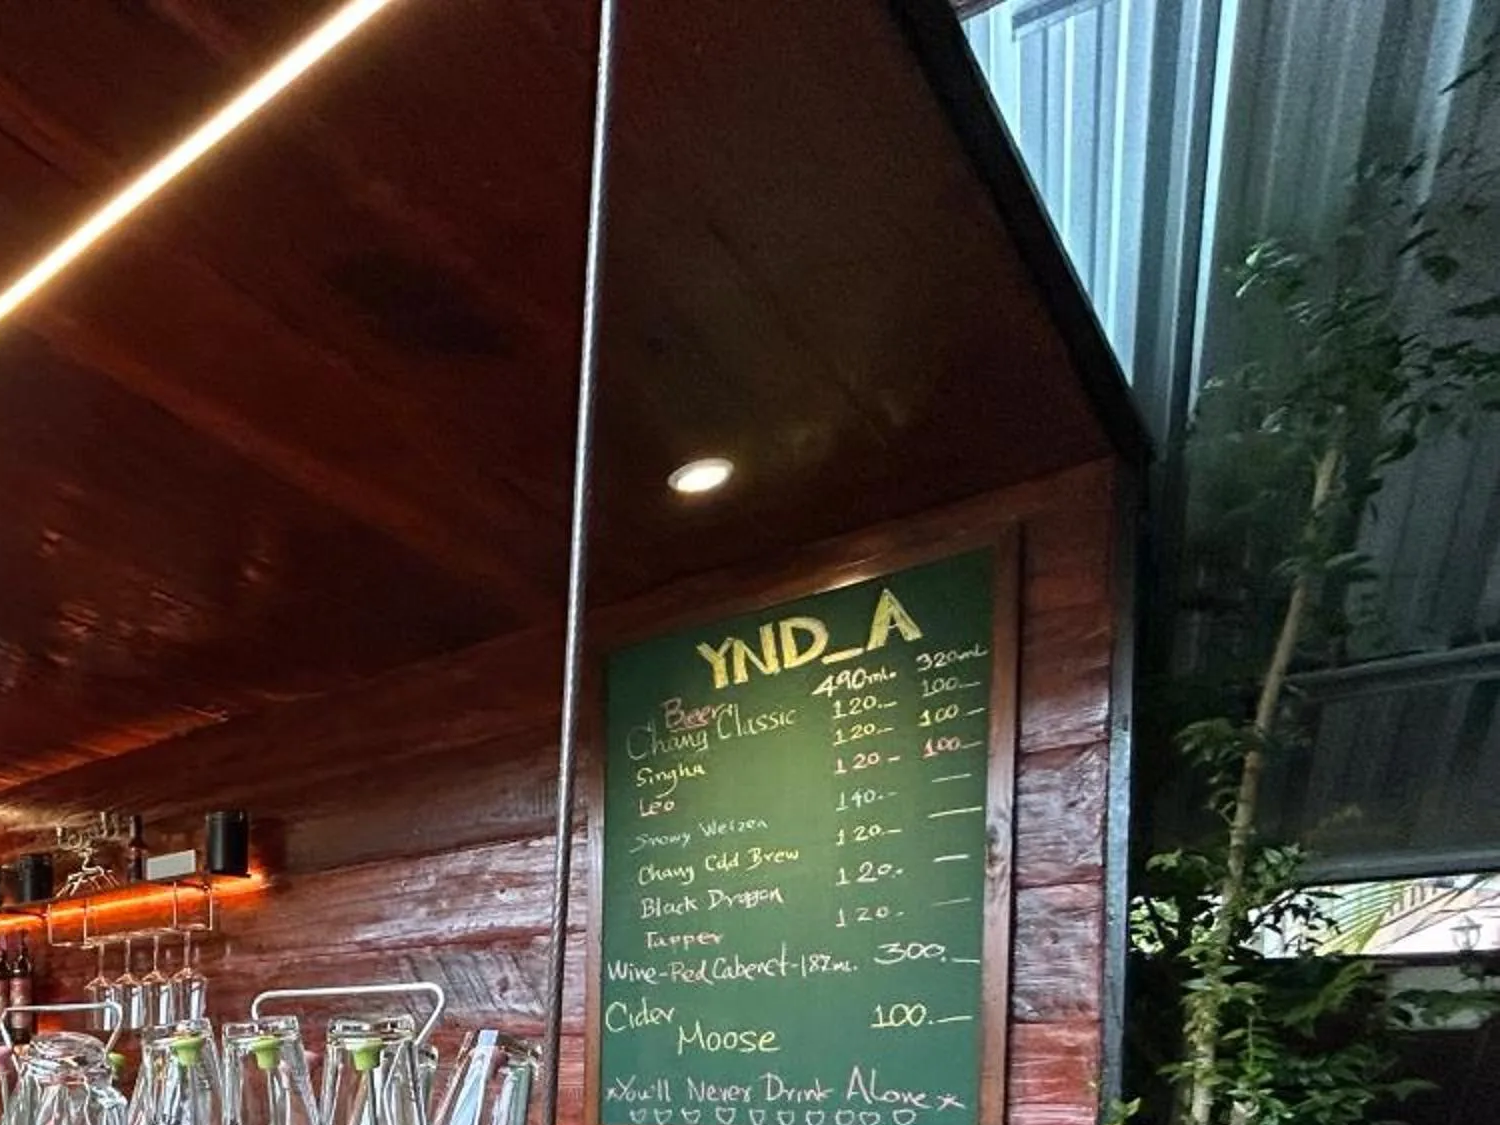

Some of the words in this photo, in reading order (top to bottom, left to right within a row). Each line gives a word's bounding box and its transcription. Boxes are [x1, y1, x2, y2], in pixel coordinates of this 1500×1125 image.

[626, 719, 709, 760] Chang
[747, 847, 800, 871] Brew
[640, 896, 699, 920] Black
[605, 996, 676, 1033] Cider
[677, 1018, 781, 1057] Moose
[760, 1070, 834, 1103] Drink
